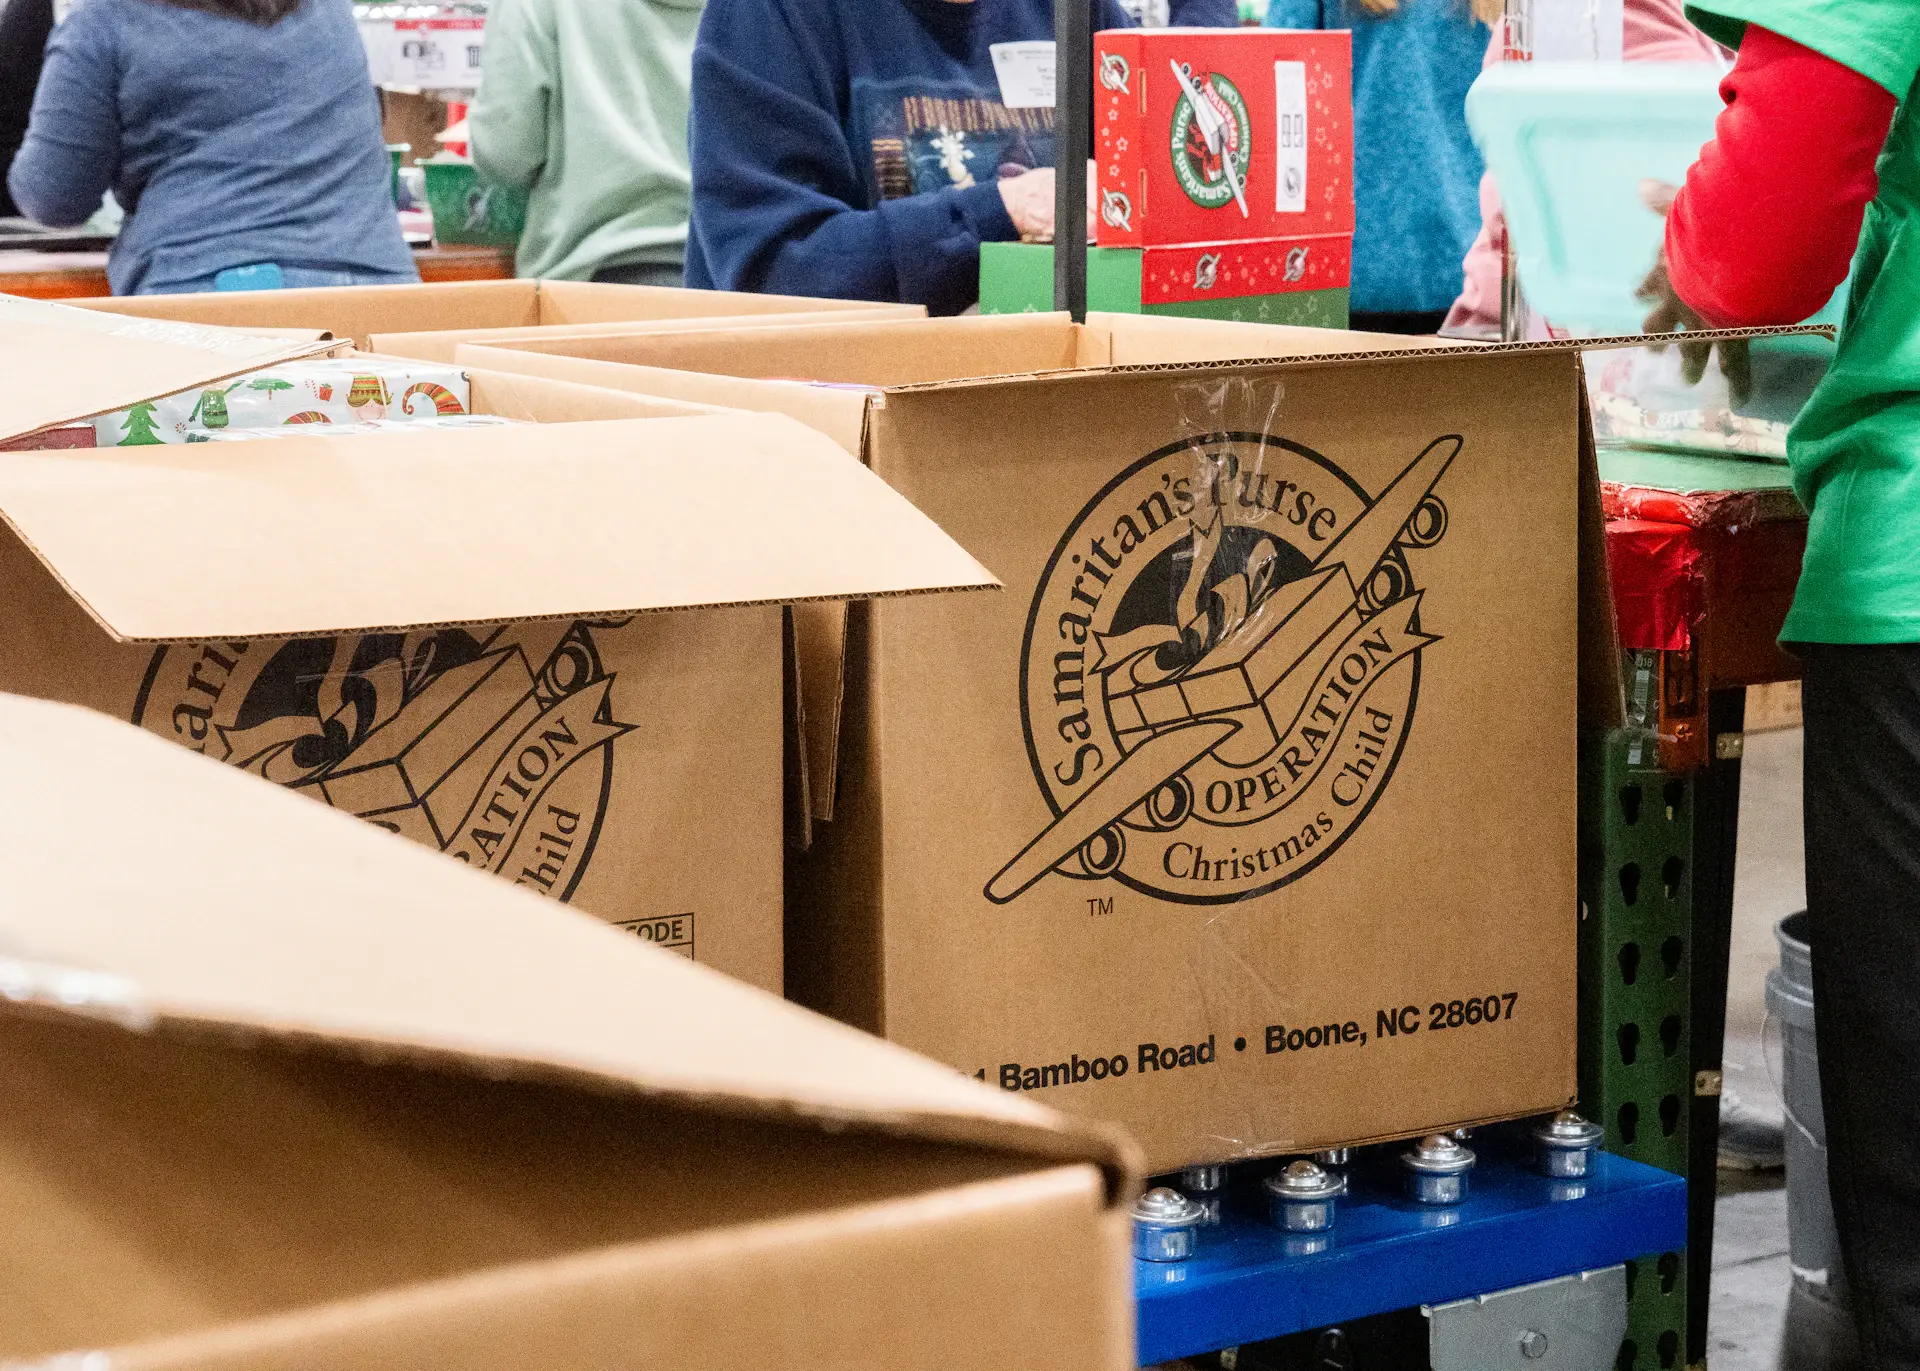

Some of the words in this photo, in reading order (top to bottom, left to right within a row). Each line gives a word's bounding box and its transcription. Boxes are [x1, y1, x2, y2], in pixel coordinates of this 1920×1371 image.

[1171, 101, 1191, 149] Purse
[1054, 473, 1195, 787] Samaritan's
[1204, 452, 1336, 541] Purse
[1205, 627, 1394, 814] OPERATION
[453, 716, 578, 868] ATION
[1163, 811, 1334, 881] Christmas
[1331, 706, 1393, 807] Child
[515, 804, 580, 895] hild
[625, 919, 683, 942] ODE
[1087, 897, 1114, 916] TM
[1000, 1054, 1129, 1092] Bamboo
[1138, 1034, 1215, 1073] Road
[1265, 1021, 1367, 1054] Boone,
[1377, 1005, 1420, 1038] NC
[1428, 992, 1518, 1030] 28607
